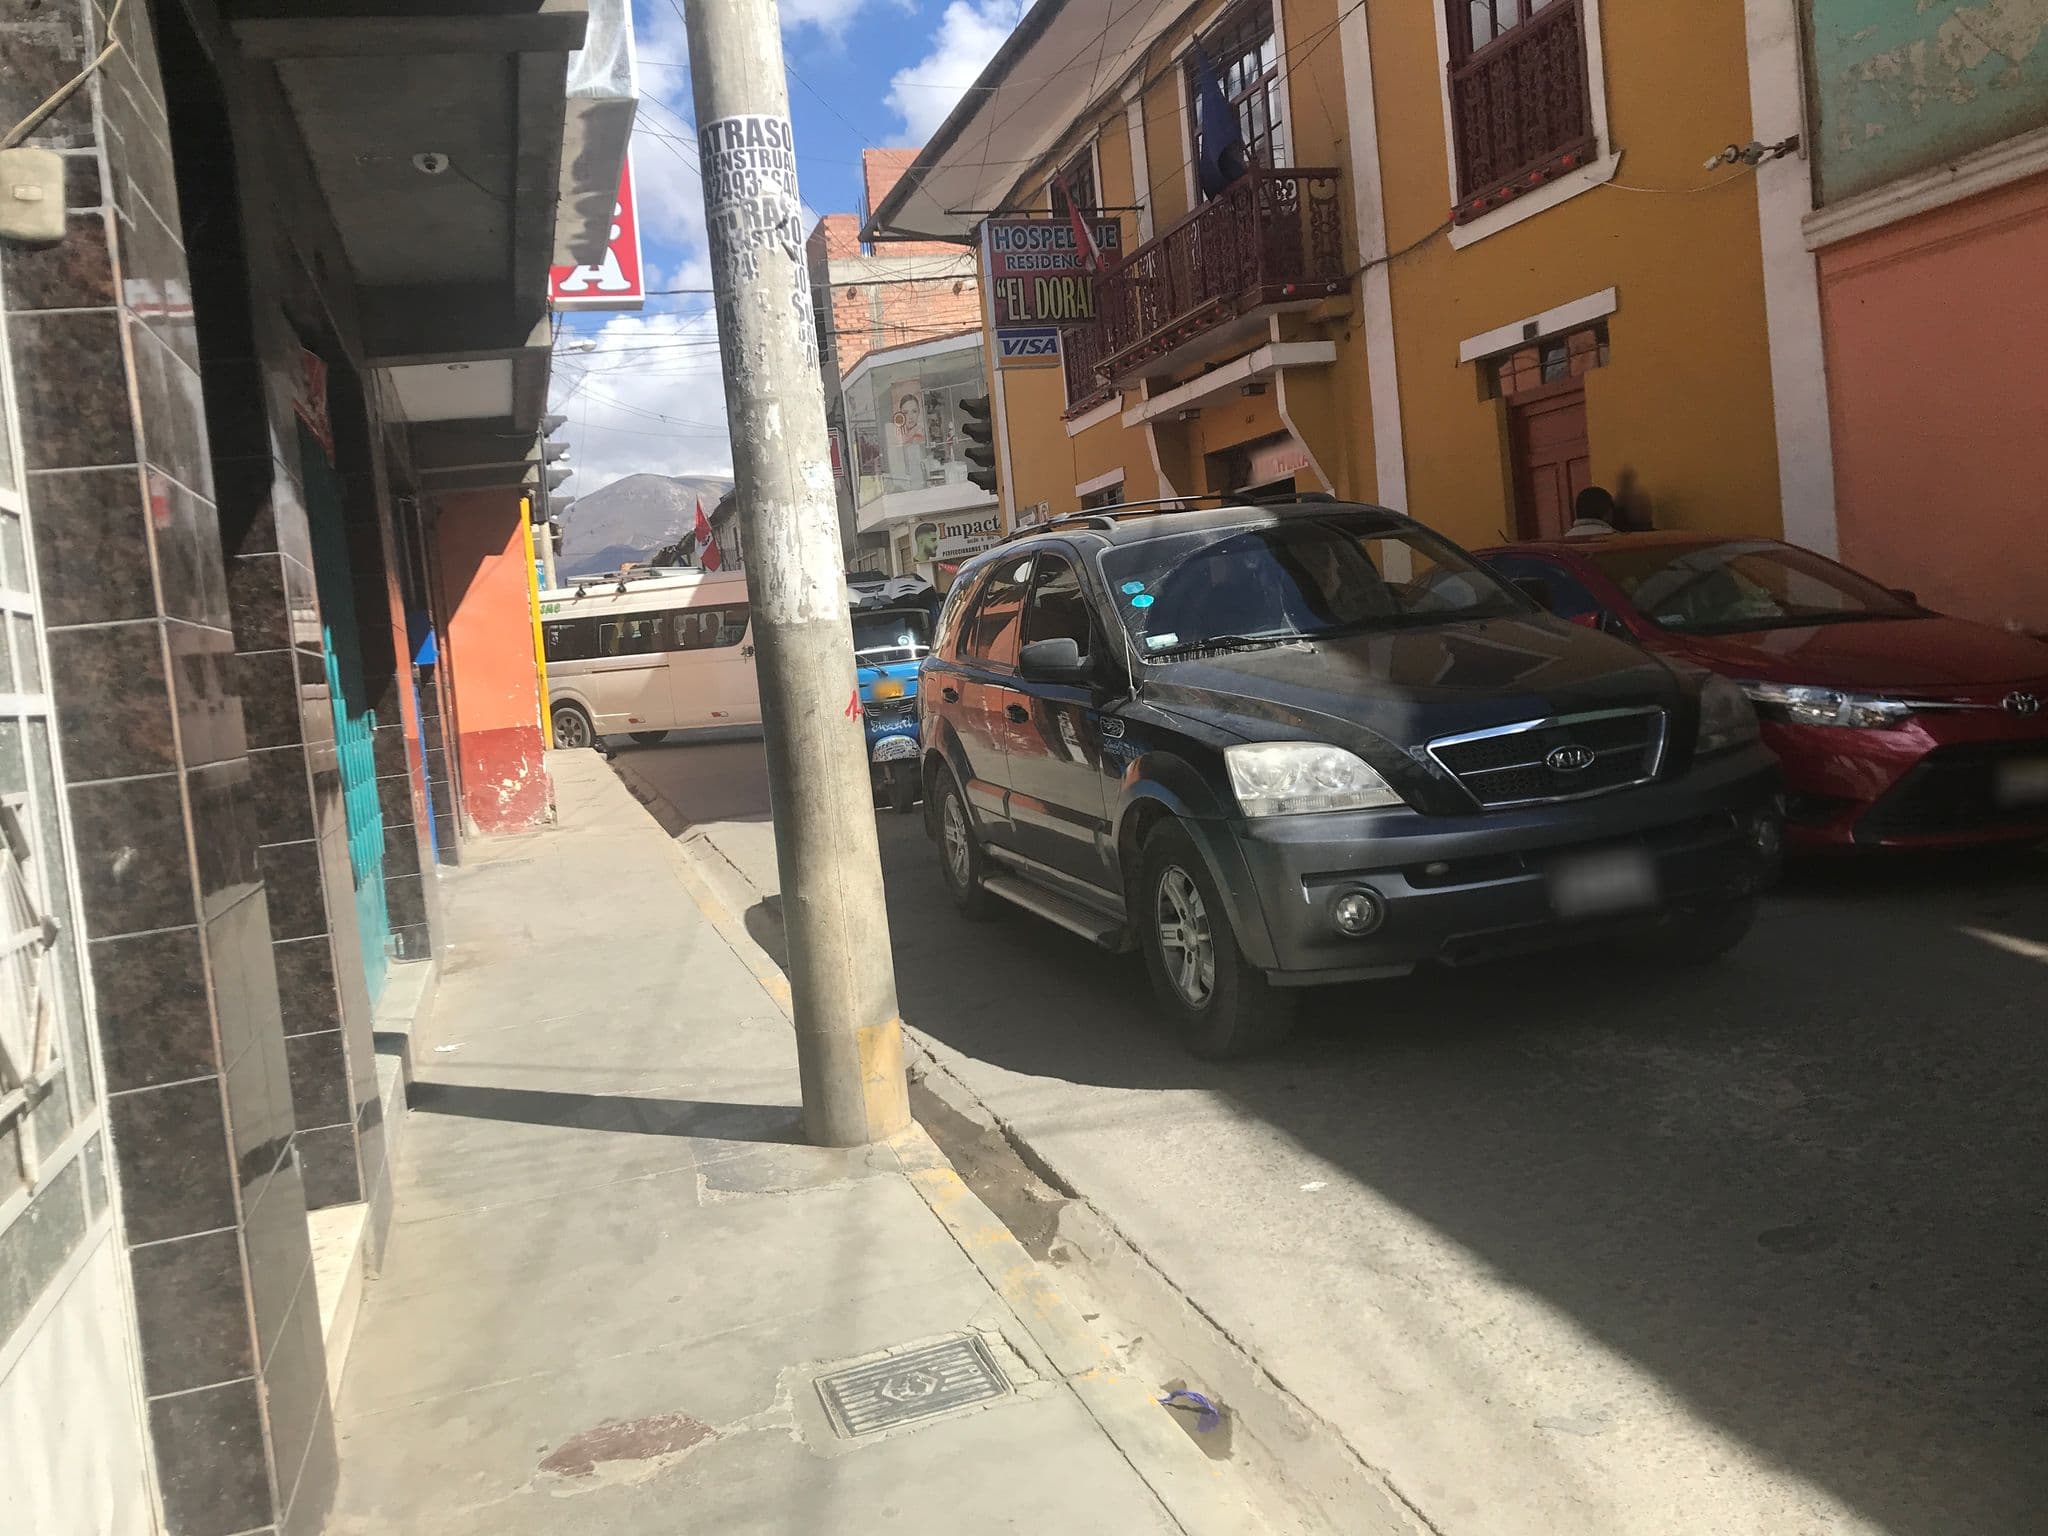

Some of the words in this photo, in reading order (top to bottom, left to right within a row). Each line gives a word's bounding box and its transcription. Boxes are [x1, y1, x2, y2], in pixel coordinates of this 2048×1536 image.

[701, 117, 792, 160] ATRASO
[994, 225, 1117, 250] HOSPEDJE
[1002, 338, 1058, 356] VISA
